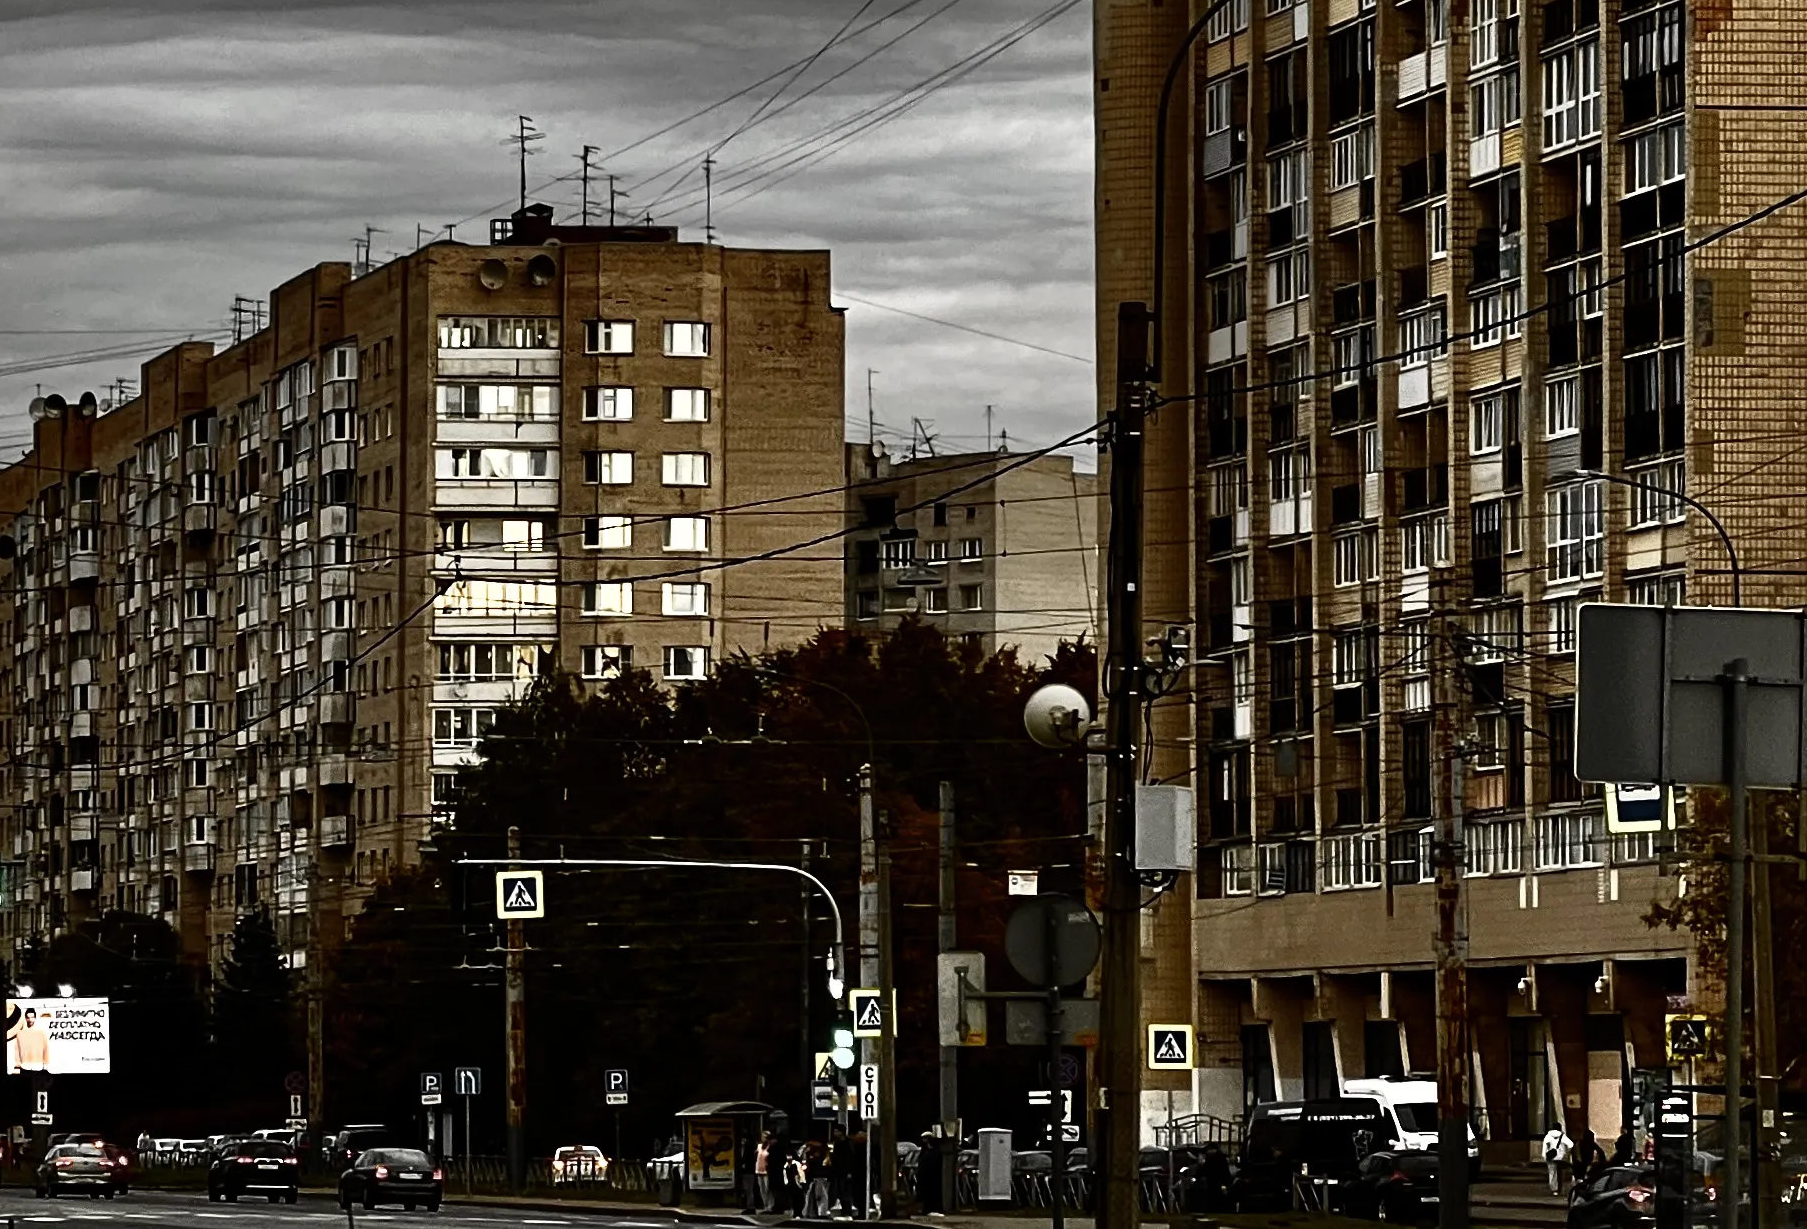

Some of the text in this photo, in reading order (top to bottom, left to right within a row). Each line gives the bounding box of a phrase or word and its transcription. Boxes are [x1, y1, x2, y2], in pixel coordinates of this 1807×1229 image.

[49, 1031, 106, 1042] НАВСЕГДА
[426, 1075, 437, 1092] P
[611, 1072, 623, 1090] P
[864, 1067, 875, 1117] СТОП
